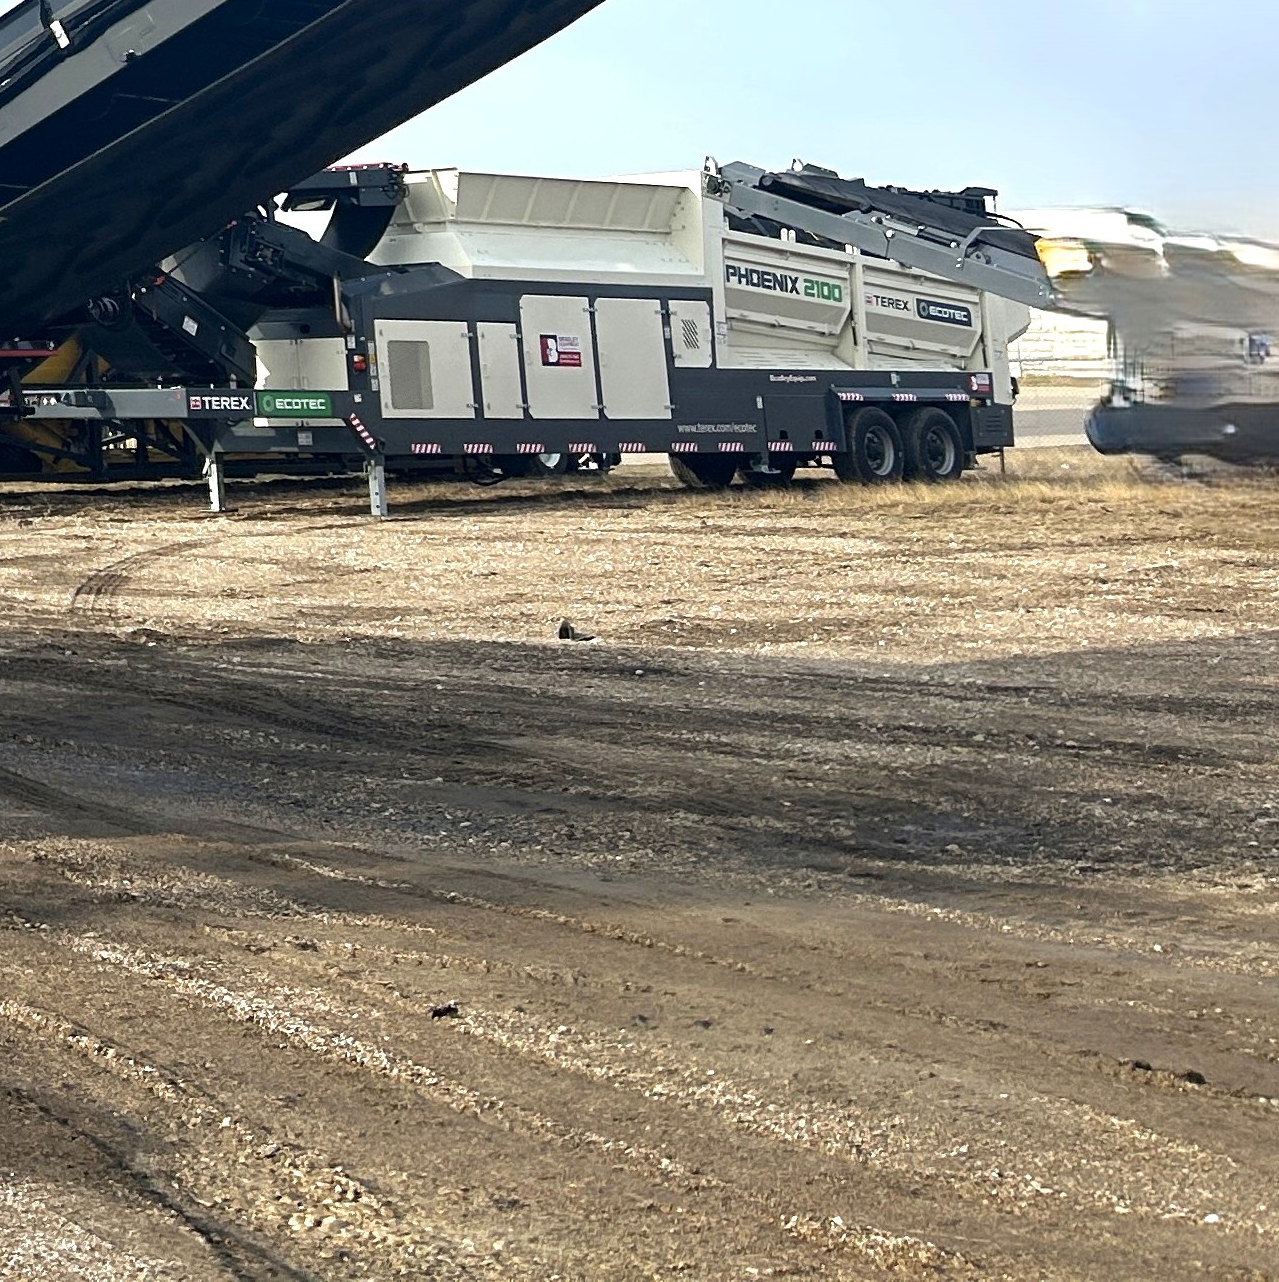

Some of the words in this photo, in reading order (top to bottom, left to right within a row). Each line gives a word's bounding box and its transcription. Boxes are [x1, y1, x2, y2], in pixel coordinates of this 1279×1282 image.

[725, 264, 801, 295] PHOENIX
[803, 278, 843, 303] 2100
[873, 295, 910, 311] TEREX
[928, 305, 968, 321] ECOTEC
[202, 396, 251, 410] TEREX
[275, 398, 326, 410] ECOTEC
